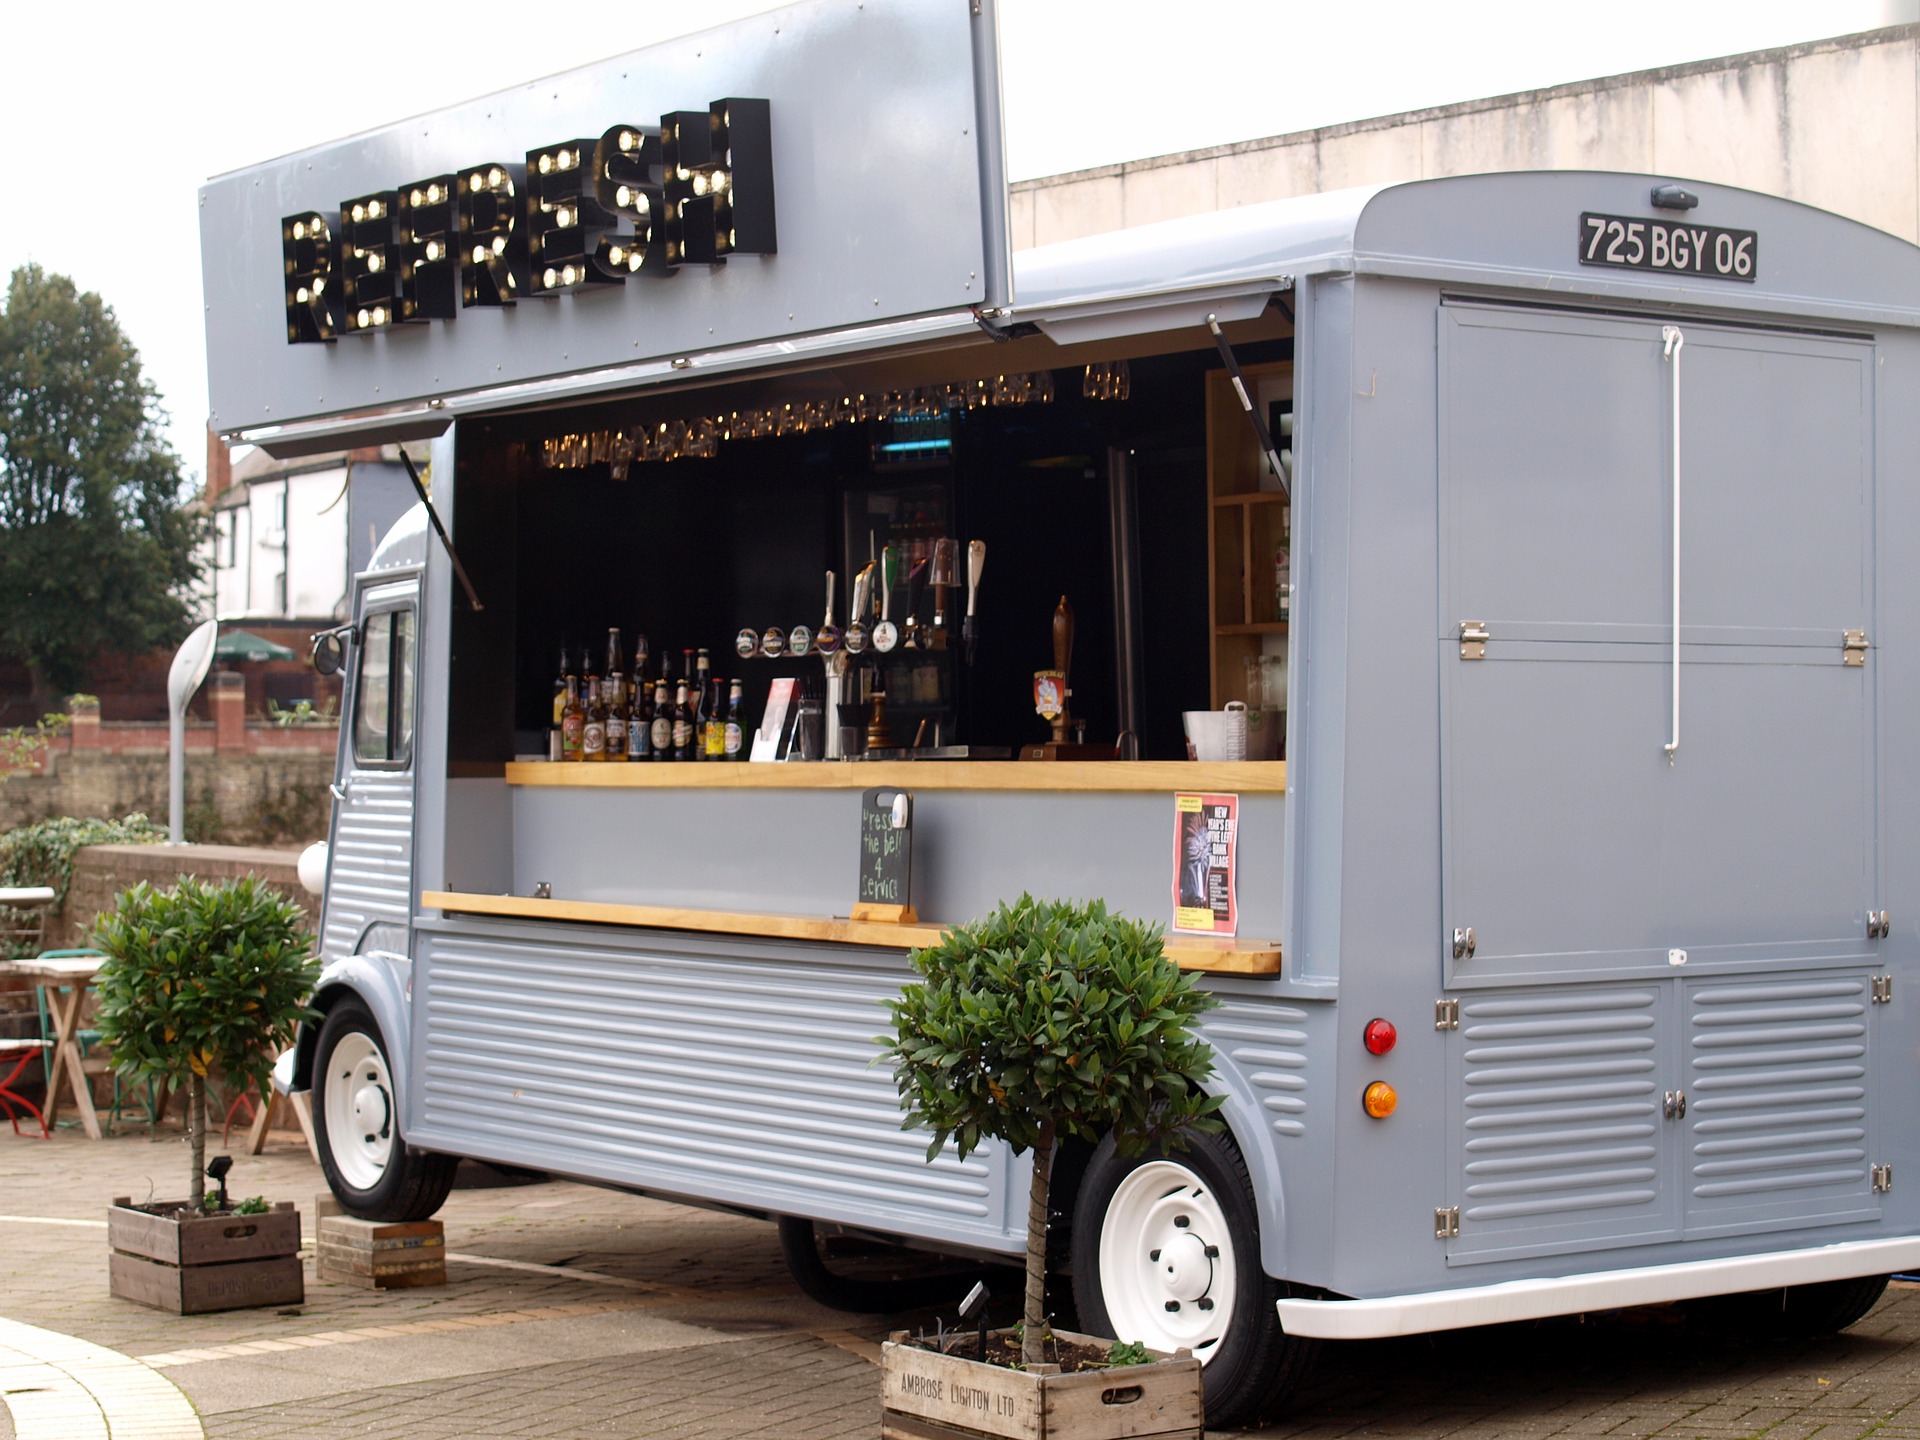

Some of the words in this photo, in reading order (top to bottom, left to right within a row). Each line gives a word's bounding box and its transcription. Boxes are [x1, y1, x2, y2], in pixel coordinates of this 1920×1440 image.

[282, 97, 777, 345] REFRESH
[1586, 217, 1645, 265] 725
[1651, 225, 1708, 272] BGY
[1714, 232, 1753, 277] 06
[1214, 806, 1228, 819] NEW
[864, 833, 880, 855] the
[875, 857, 883, 879] 4
[901, 1372, 943, 1401] AMBROSE
[950, 1383, 990, 1412] LIGHTON
[997, 1394, 1014, 1417] LTD
